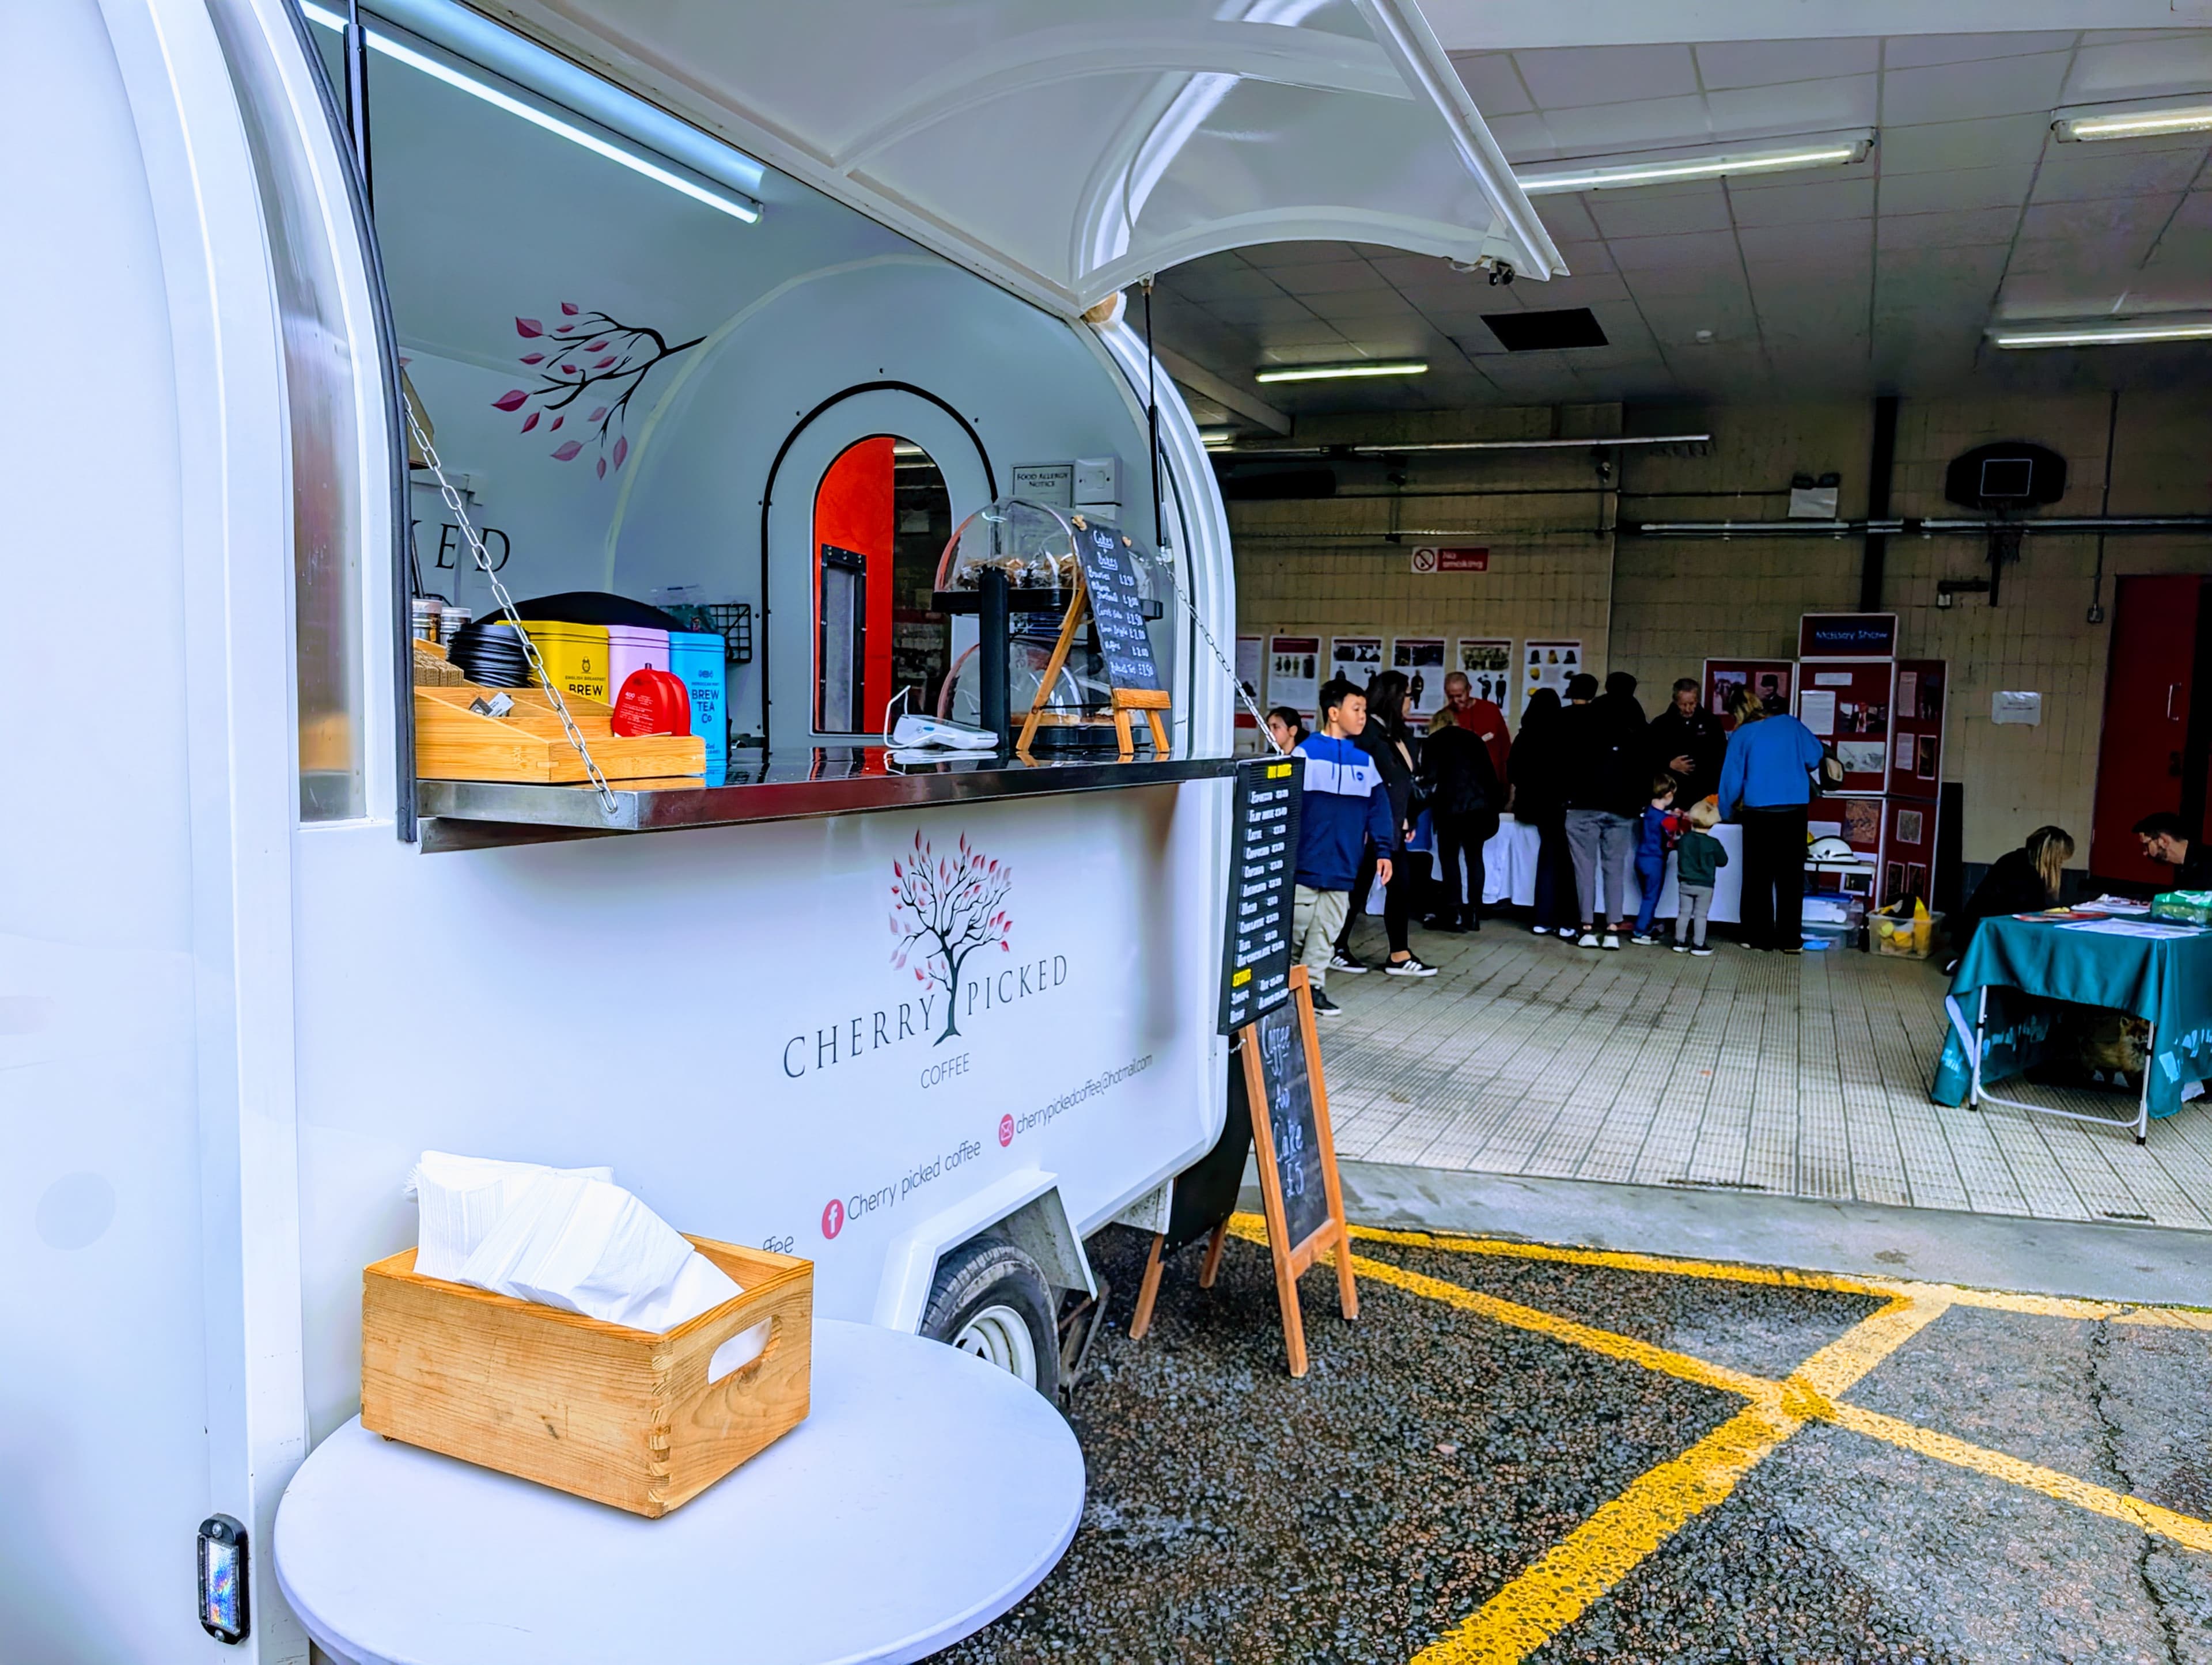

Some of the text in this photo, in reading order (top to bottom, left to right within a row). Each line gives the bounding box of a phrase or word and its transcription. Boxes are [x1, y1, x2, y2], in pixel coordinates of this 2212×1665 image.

[1442, 551, 1457, 559] No
[569, 684, 603, 696] BREW
[692, 689, 719, 700] BREW
[697, 701, 715, 712] TEA
[701, 713, 712, 723] Co
[783, 953, 1067, 1079] CHERRY PICKED
[921, 1052, 971, 1090] COFFEE
[1016, 1054, 1153, 1134] cherrypickedcoffee@hotmail.com
[848, 1184, 897, 1221] Cherry
[901, 1154, 941, 1201] picked
[945, 1139, 982, 1171] coffee
